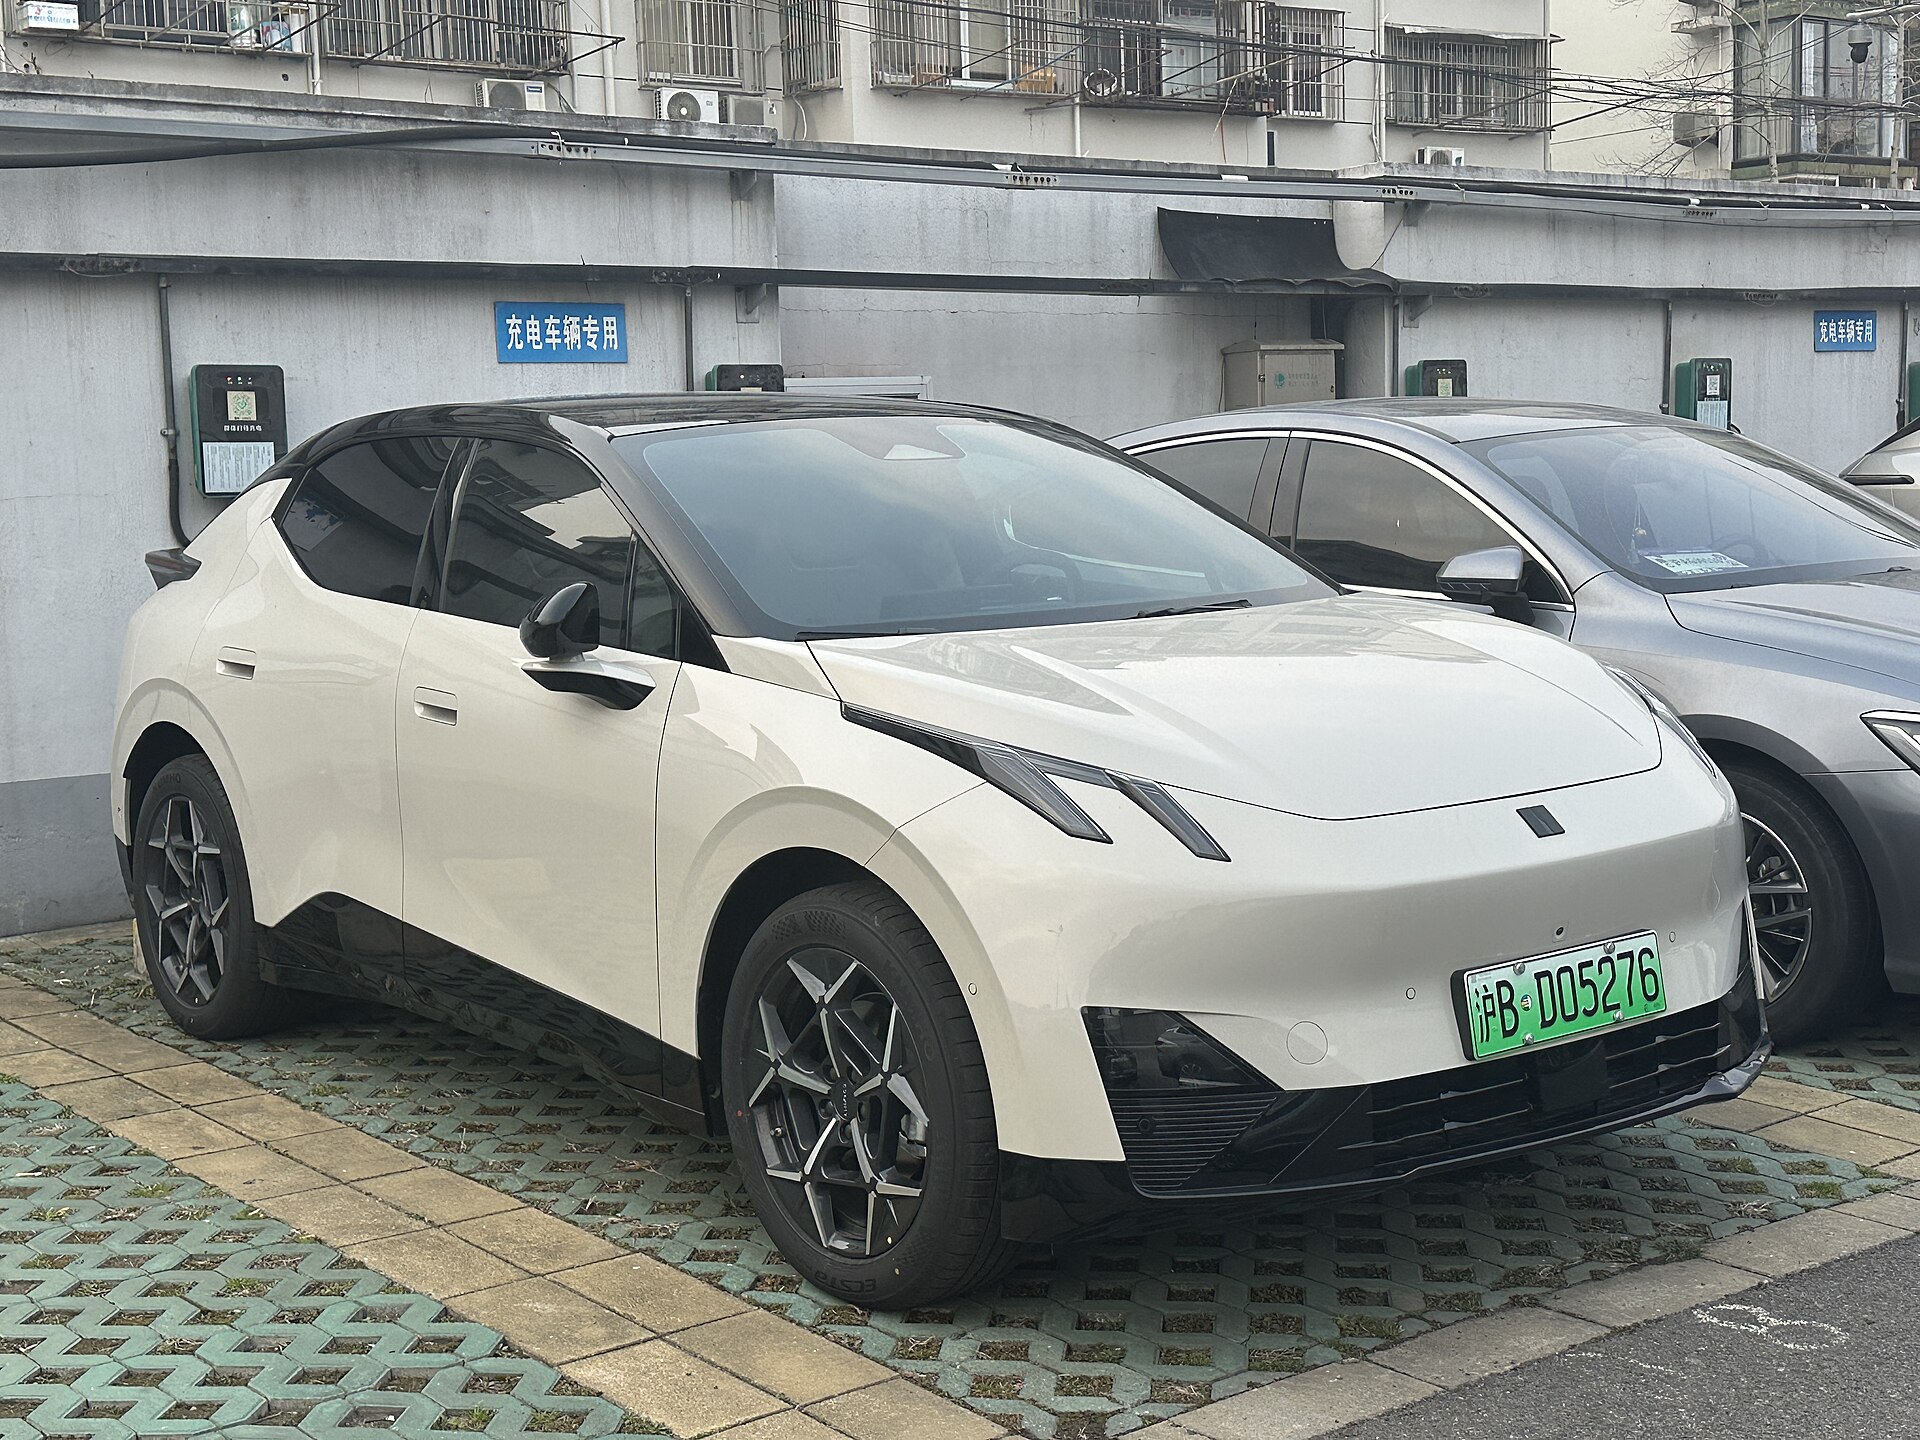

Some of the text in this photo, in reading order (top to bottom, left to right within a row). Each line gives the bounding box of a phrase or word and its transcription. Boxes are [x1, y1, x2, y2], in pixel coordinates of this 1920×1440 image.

[505, 313, 619, 351] 充电车辆专用
[1819, 318, 1873, 343] 充电车辆专用
